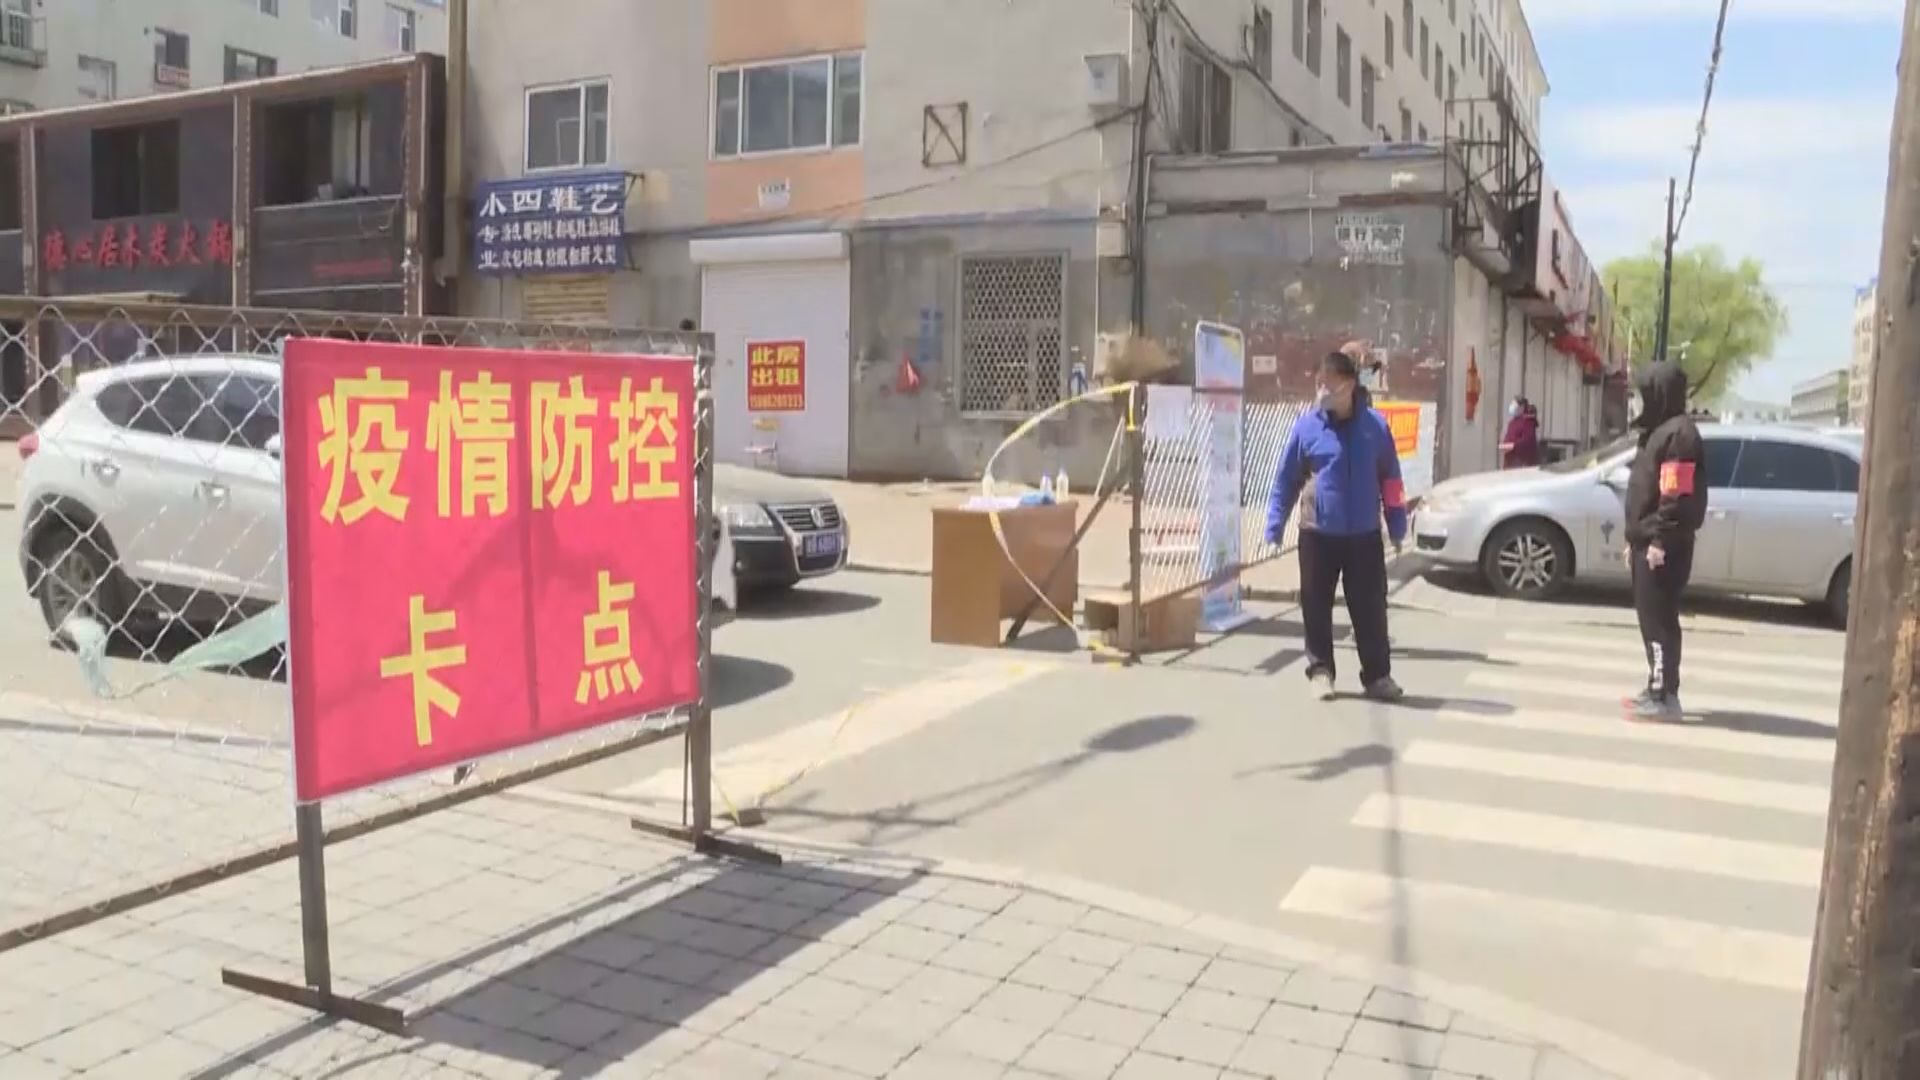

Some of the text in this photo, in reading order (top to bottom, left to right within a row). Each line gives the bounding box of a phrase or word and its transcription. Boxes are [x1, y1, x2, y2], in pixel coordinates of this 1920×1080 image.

[479, 183, 620, 217] 小四鞋艺
[752, 346, 800, 366] 此房
[752, 367, 800, 387] 出租
[317, 366, 681, 526] 疫情防控
[380, 570, 644, 747] 卡点
